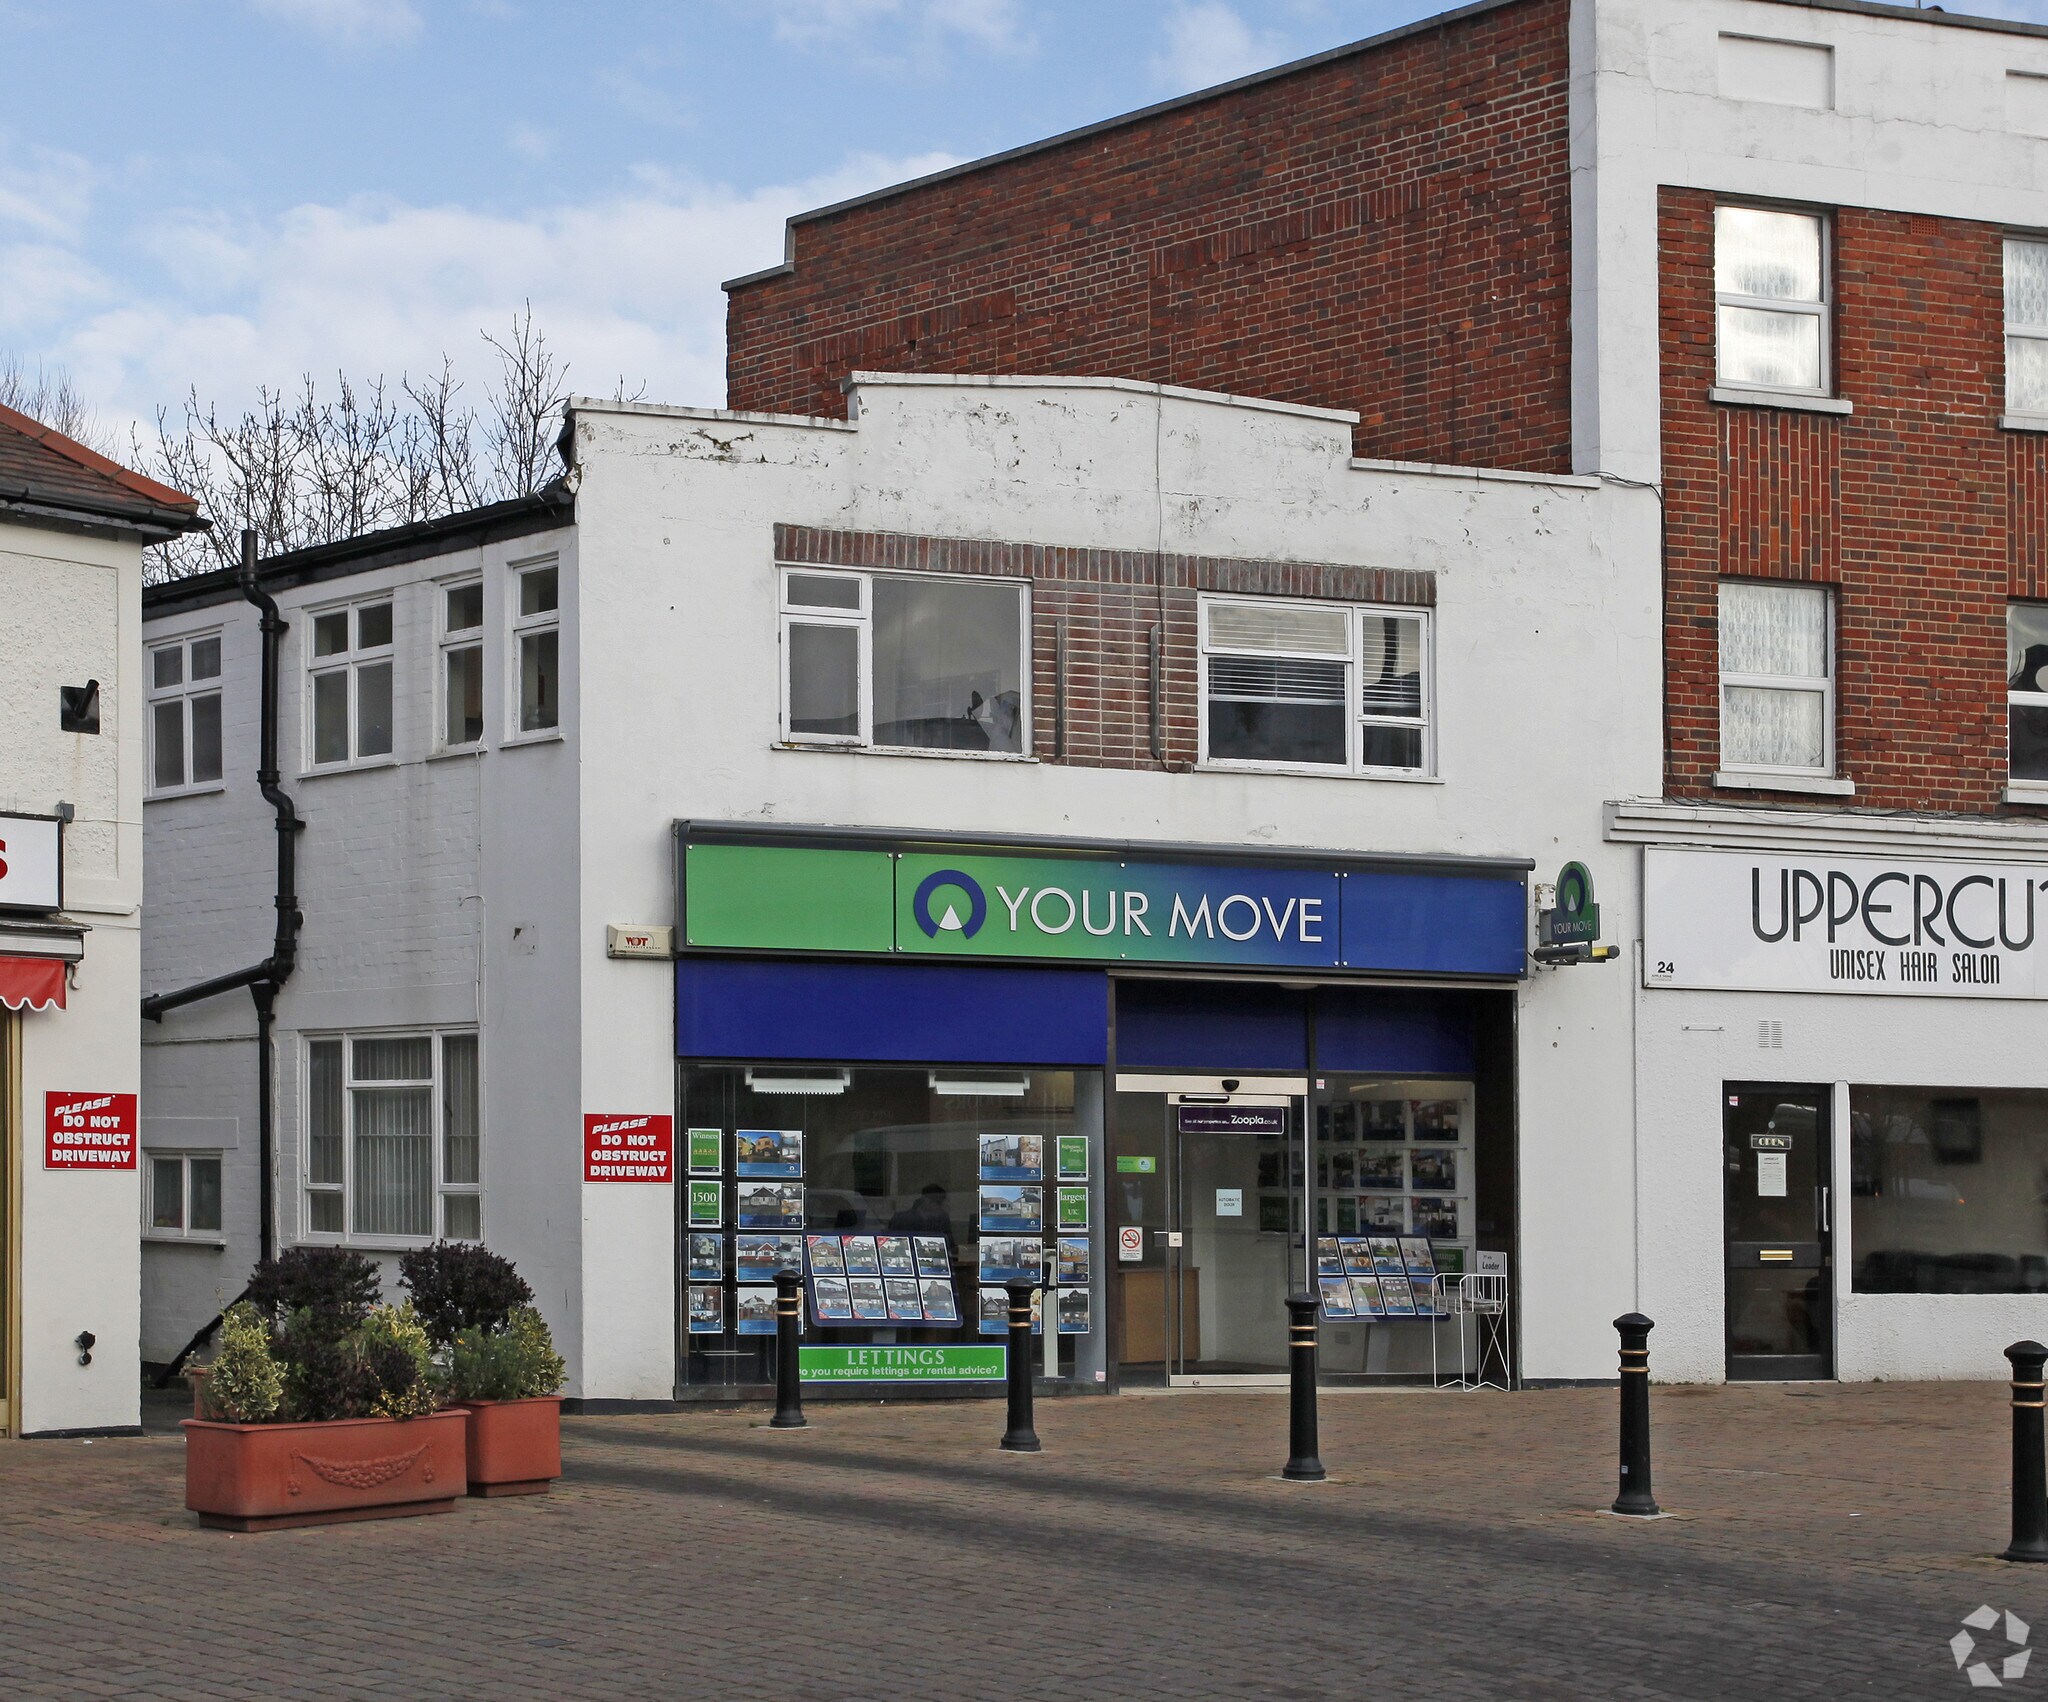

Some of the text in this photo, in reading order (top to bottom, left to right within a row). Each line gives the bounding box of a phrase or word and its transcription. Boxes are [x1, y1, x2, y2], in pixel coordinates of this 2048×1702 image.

[996, 886, 1322, 942] YOUR MOVE
[1553, 920, 1592, 934] YOUR MOVE
[1657, 961, 1675, 974] 24
[1830, 949, 2000, 984] UNISEX HAIR SALON
[54, 1096, 112, 1117] PLEASE
[63, 1115, 120, 1128] DO NOT
[592, 1118, 648, 1135] PLEASE
[53, 1132, 131, 1146] OBSTRUCT
[601, 1134, 657, 1146] DO NOT
[691, 1131, 719, 1140] Winners
[52, 1149, 131, 1163] DRIVEWAY
[591, 1149, 667, 1162] OBSTRUCT
[590, 1165, 667, 1177] DRIVEWAY
[692, 1192, 717, 1203] 1500
[1060, 1191, 1086, 1204] largest
[1482, 1261, 1500, 1271] Leader
[847, 1349, 945, 1365] LETTINGS
[811, 1368, 831, 1377] you
[833, 1366, 869, 1377] require
[871, 1366, 910, 1377] lettings
[912, 1367, 925, 1376] or
[926, 1365, 956, 1376] rental
[958, 1365, 998, 1375] advice?
